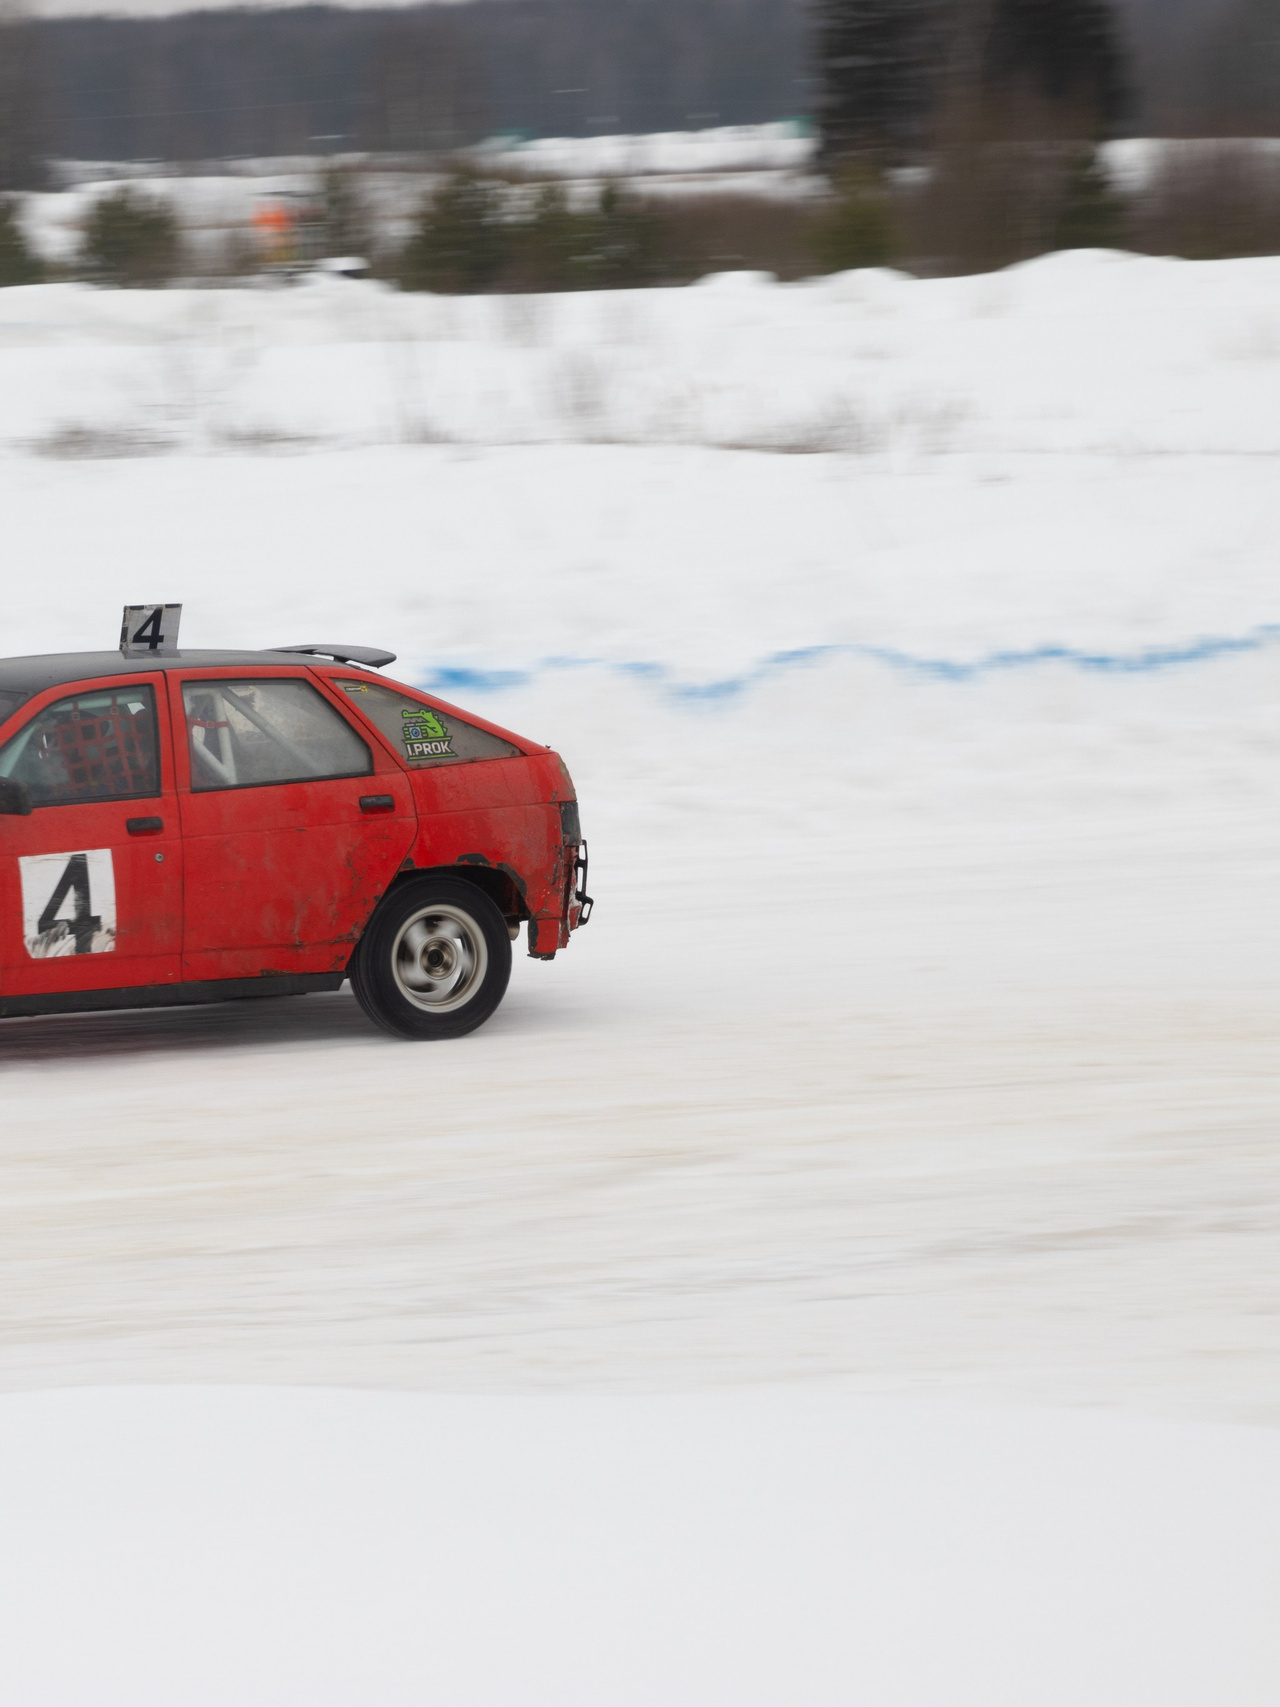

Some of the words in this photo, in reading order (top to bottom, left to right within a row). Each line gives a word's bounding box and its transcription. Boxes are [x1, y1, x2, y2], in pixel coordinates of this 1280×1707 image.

[132, 606, 164, 649] 4
[406, 741, 451, 756] I.PROK
[37, 853, 102, 954] 4
